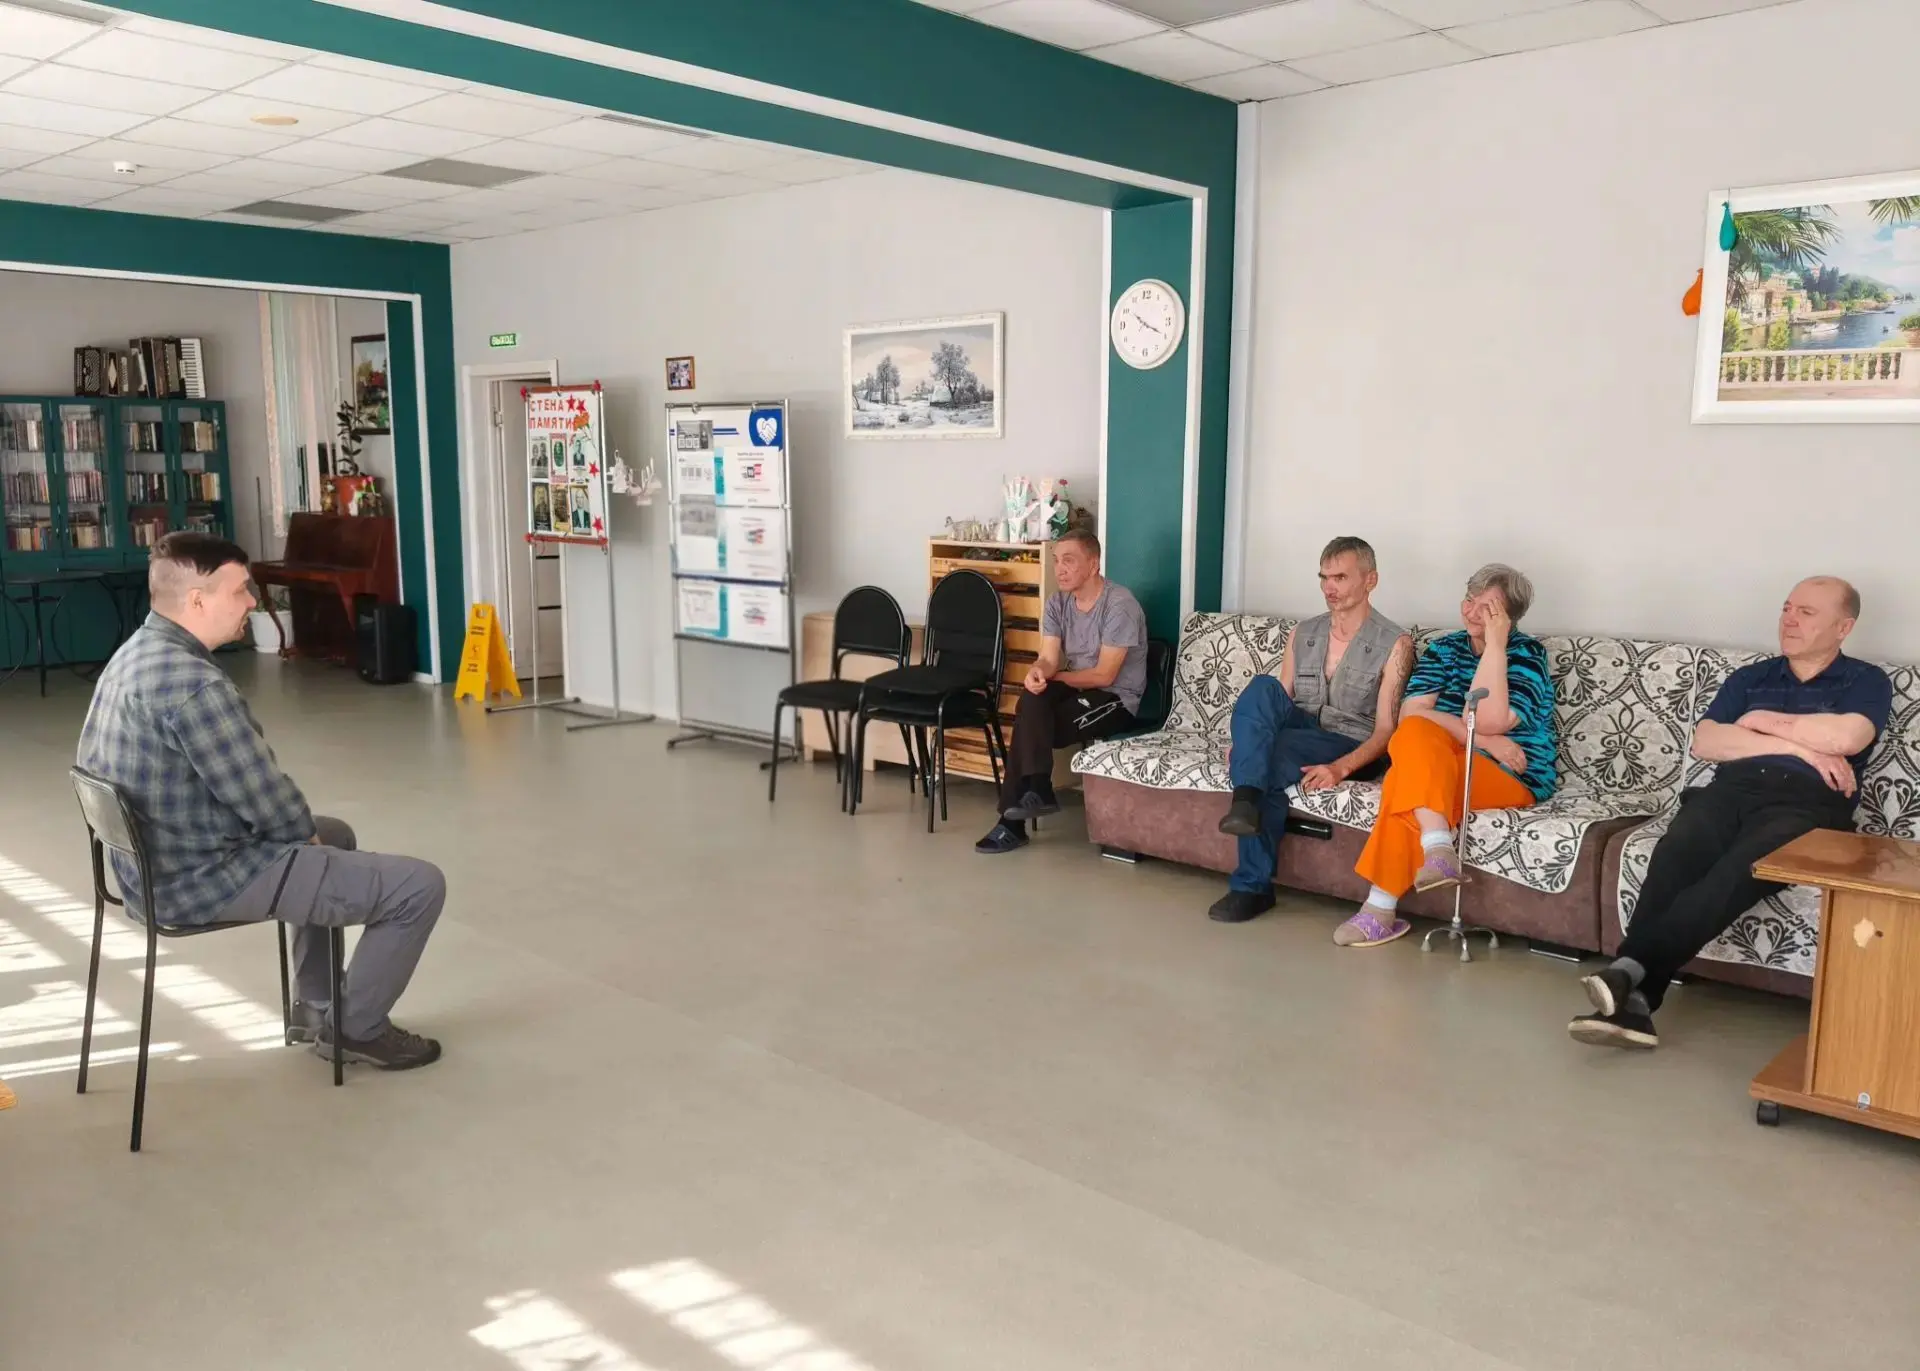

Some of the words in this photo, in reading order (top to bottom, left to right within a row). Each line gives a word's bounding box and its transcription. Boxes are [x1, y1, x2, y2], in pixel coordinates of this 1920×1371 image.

[1142, 290, 1152, 300] 12
[529, 398, 564, 412] СТЕНА
[529, 416, 572, 431] ПАМЯТИ
